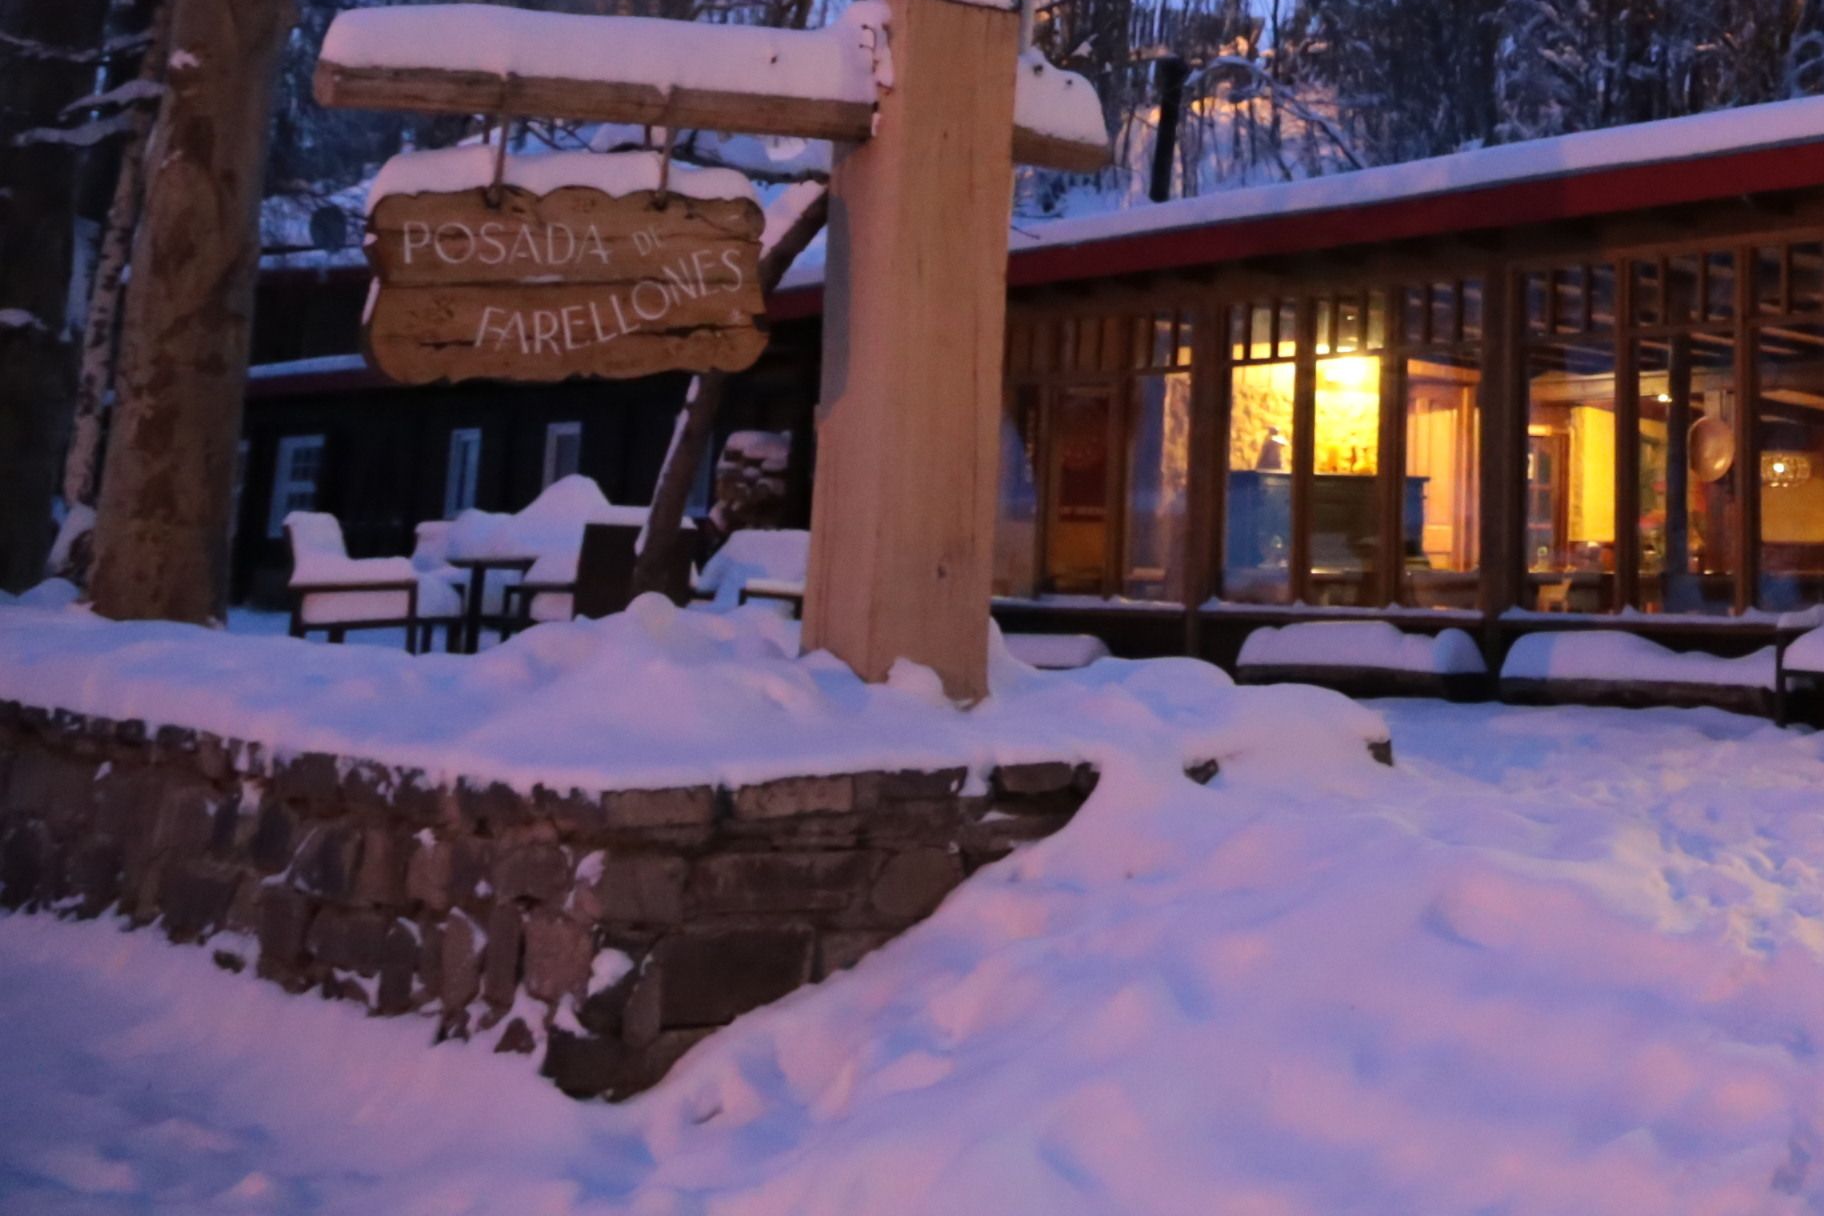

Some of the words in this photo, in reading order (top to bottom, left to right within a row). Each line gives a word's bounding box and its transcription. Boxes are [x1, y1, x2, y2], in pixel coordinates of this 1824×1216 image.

[403, 221, 612, 265] POSADA
[632, 225, 667, 257] DE
[474, 248, 744, 356] FARELLONES
